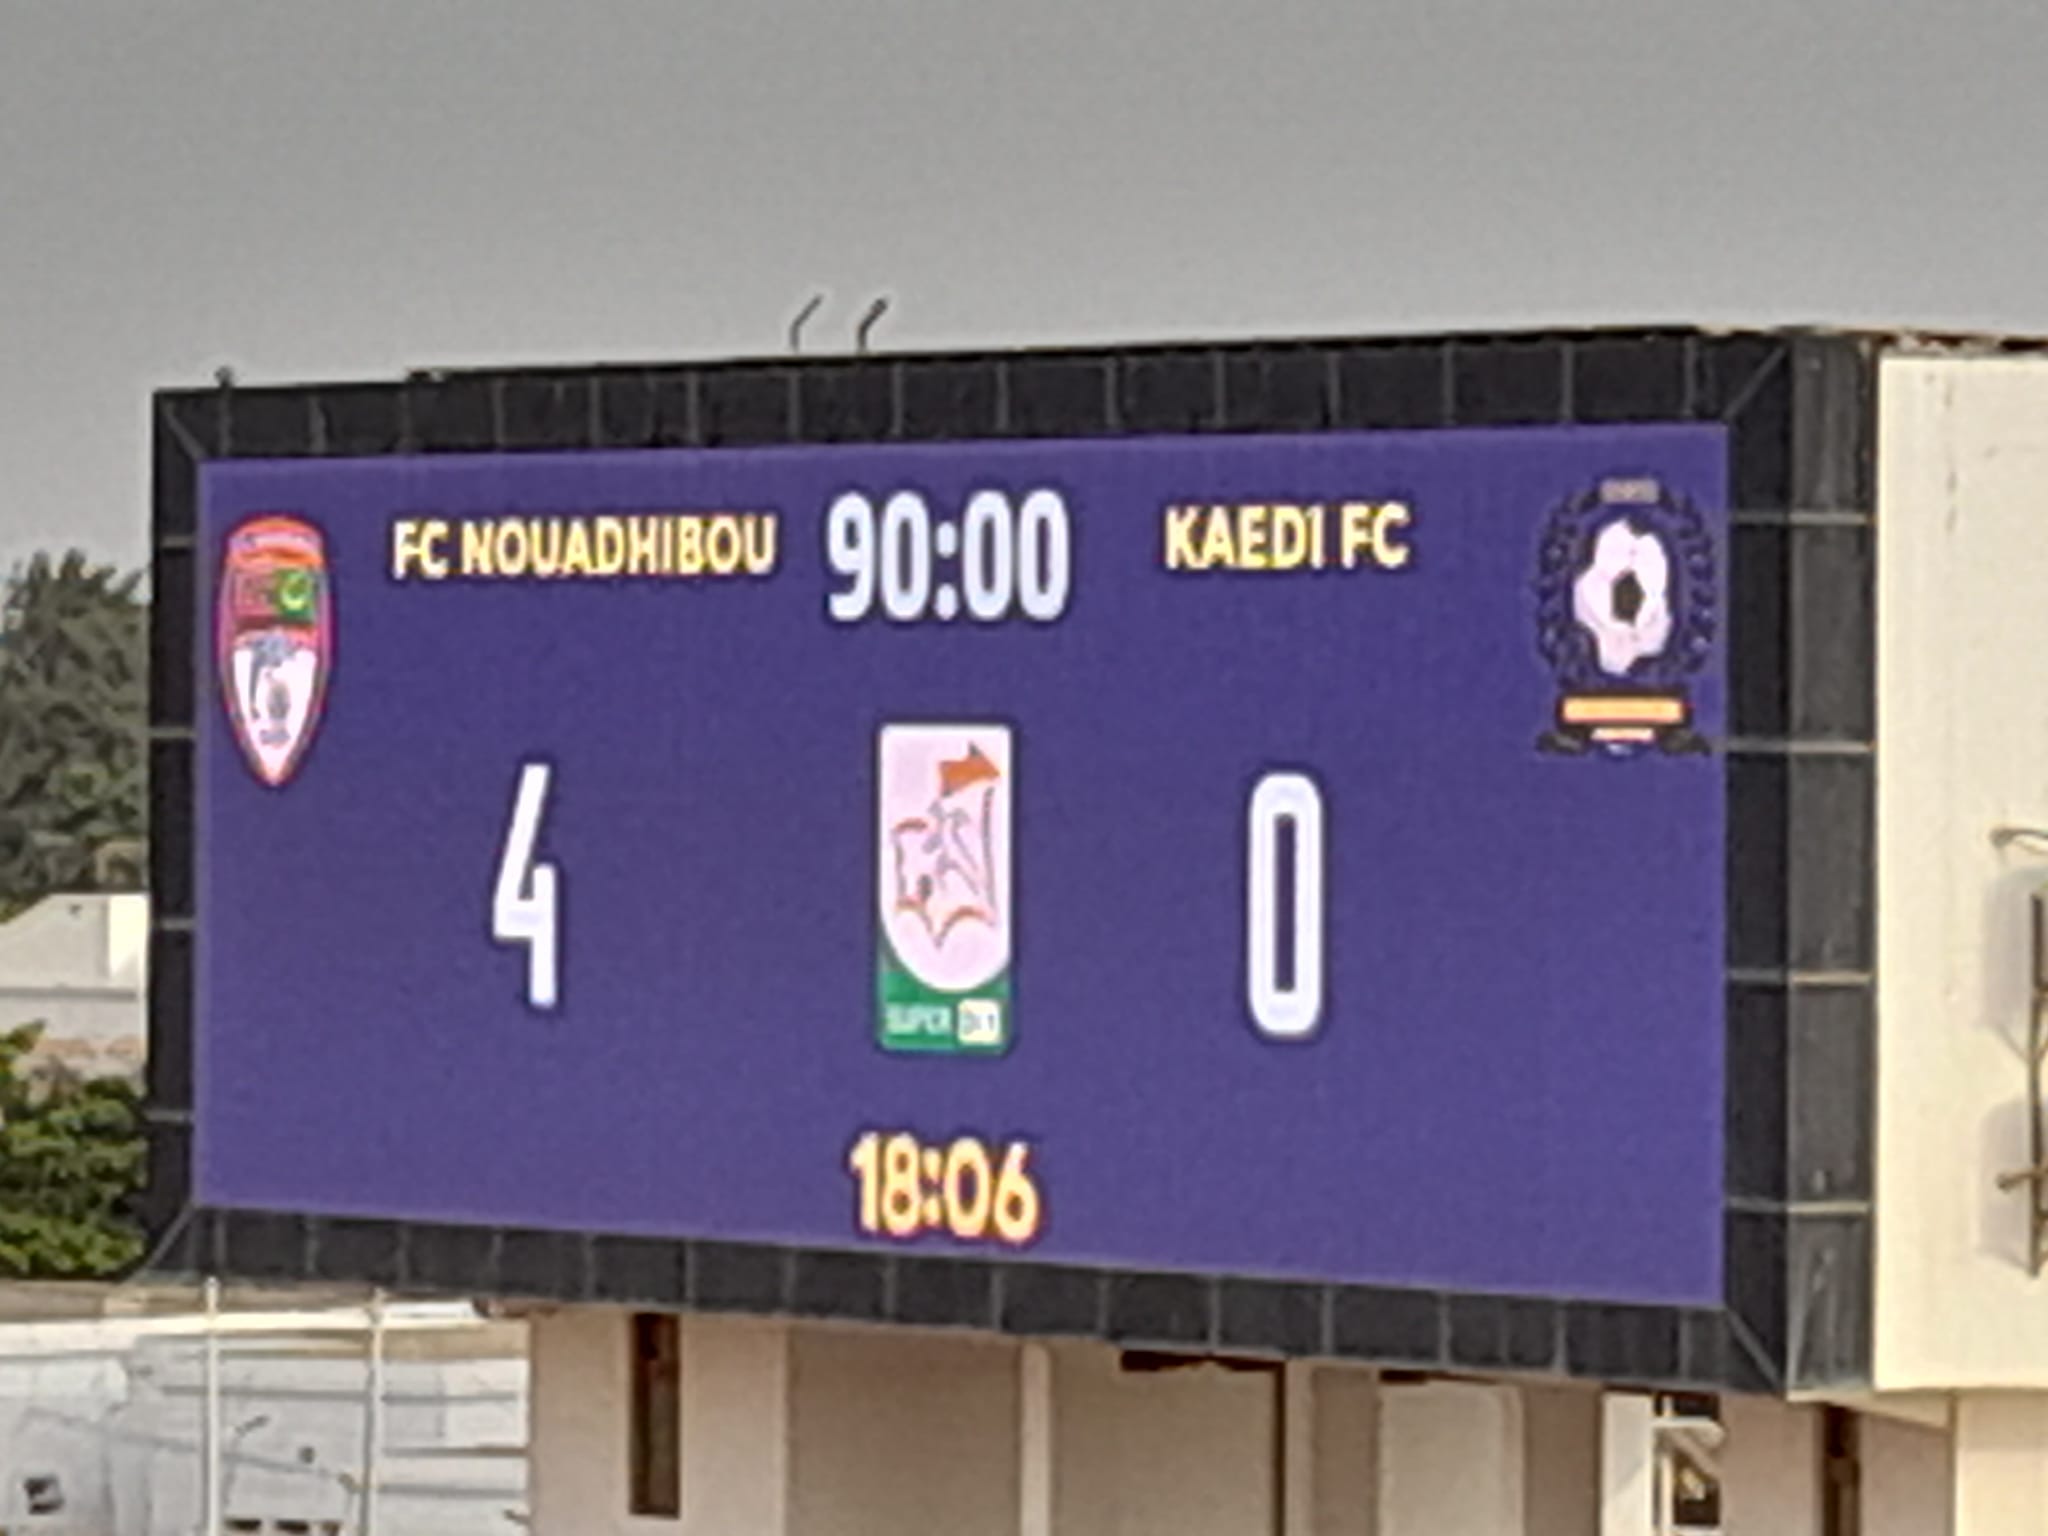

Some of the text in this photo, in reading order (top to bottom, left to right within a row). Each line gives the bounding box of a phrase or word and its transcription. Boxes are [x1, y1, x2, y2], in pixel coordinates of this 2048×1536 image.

[393, 514, 776, 580] FC NOUADHIBOU
[828, 490, 1070, 621] 90:00
[1340, 502, 1410, 568] FC
[493, 763, 557, 1008] 4
[1248, 773, 1322, 1035] 0
[850, 1131, 1040, 1245] 18:06
